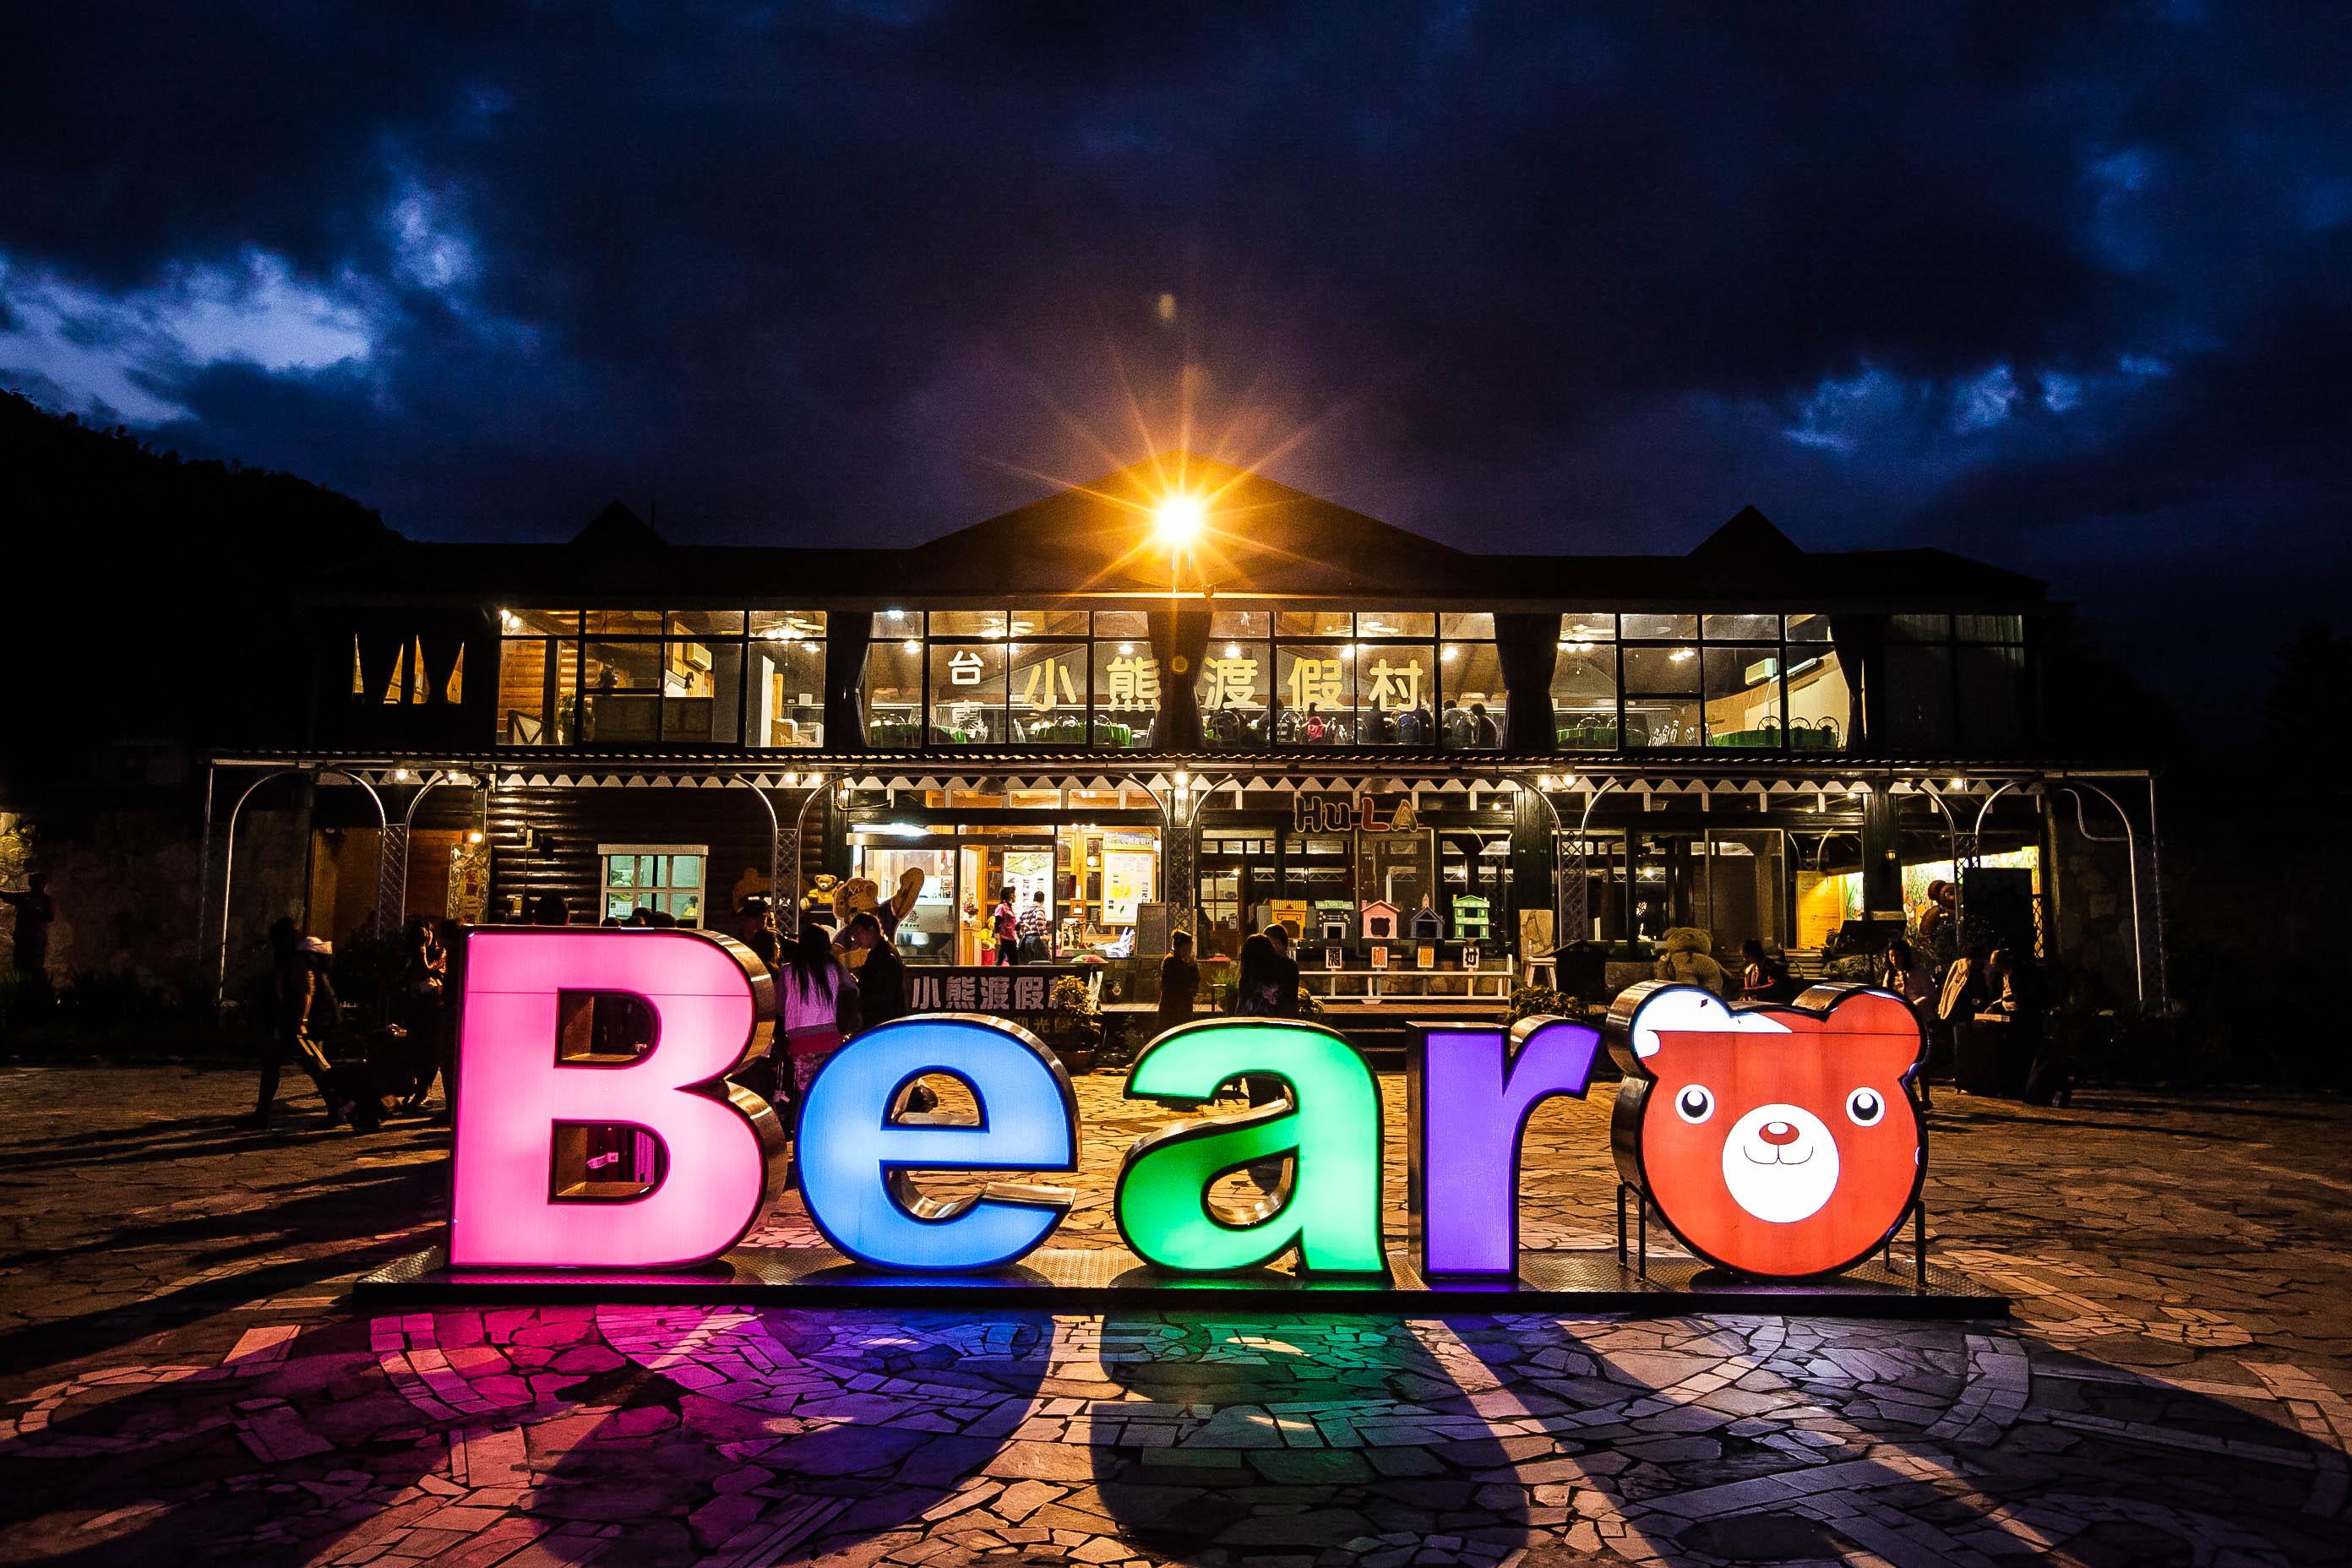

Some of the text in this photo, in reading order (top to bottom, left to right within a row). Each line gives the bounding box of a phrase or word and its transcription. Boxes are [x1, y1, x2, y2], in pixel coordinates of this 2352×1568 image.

[1023, 656, 1424, 712] 小熊渡假村
[449, 927, 1602, 1276] Bear
